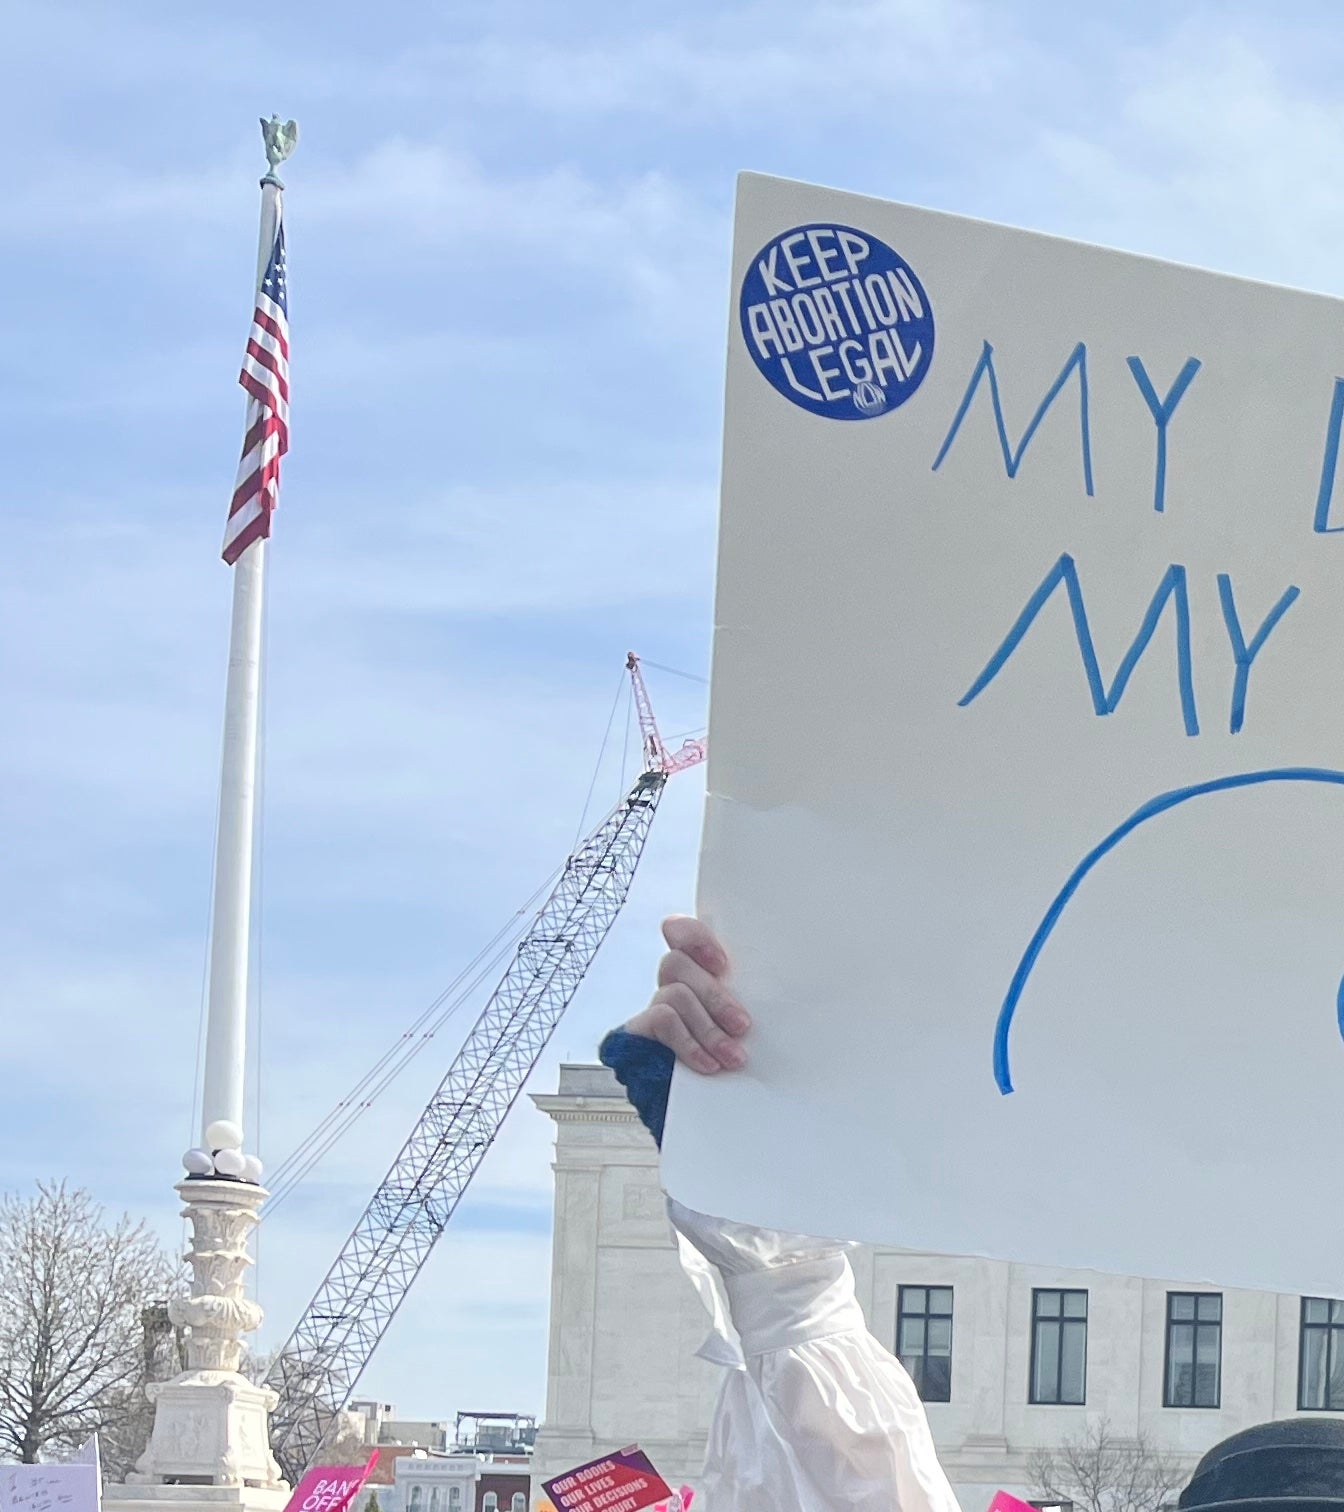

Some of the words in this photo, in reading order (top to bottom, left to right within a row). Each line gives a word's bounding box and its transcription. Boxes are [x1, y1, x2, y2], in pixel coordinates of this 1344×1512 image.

[759, 230, 869, 296] KEEP
[748, 268, 923, 359] ABORTION
[781, 328, 921, 401] LEGAL
[932, 341, 1201, 512] MY
[957, 552, 1300, 736] MY
[552, 1476, 577, 1495] OUR
[577, 1459, 616, 1484] BODIES
[560, 1489, 585, 1508] OUR
[586, 1475, 615, 1496] LIVES
[594, 1477, 648, 1509] DECISIONS
